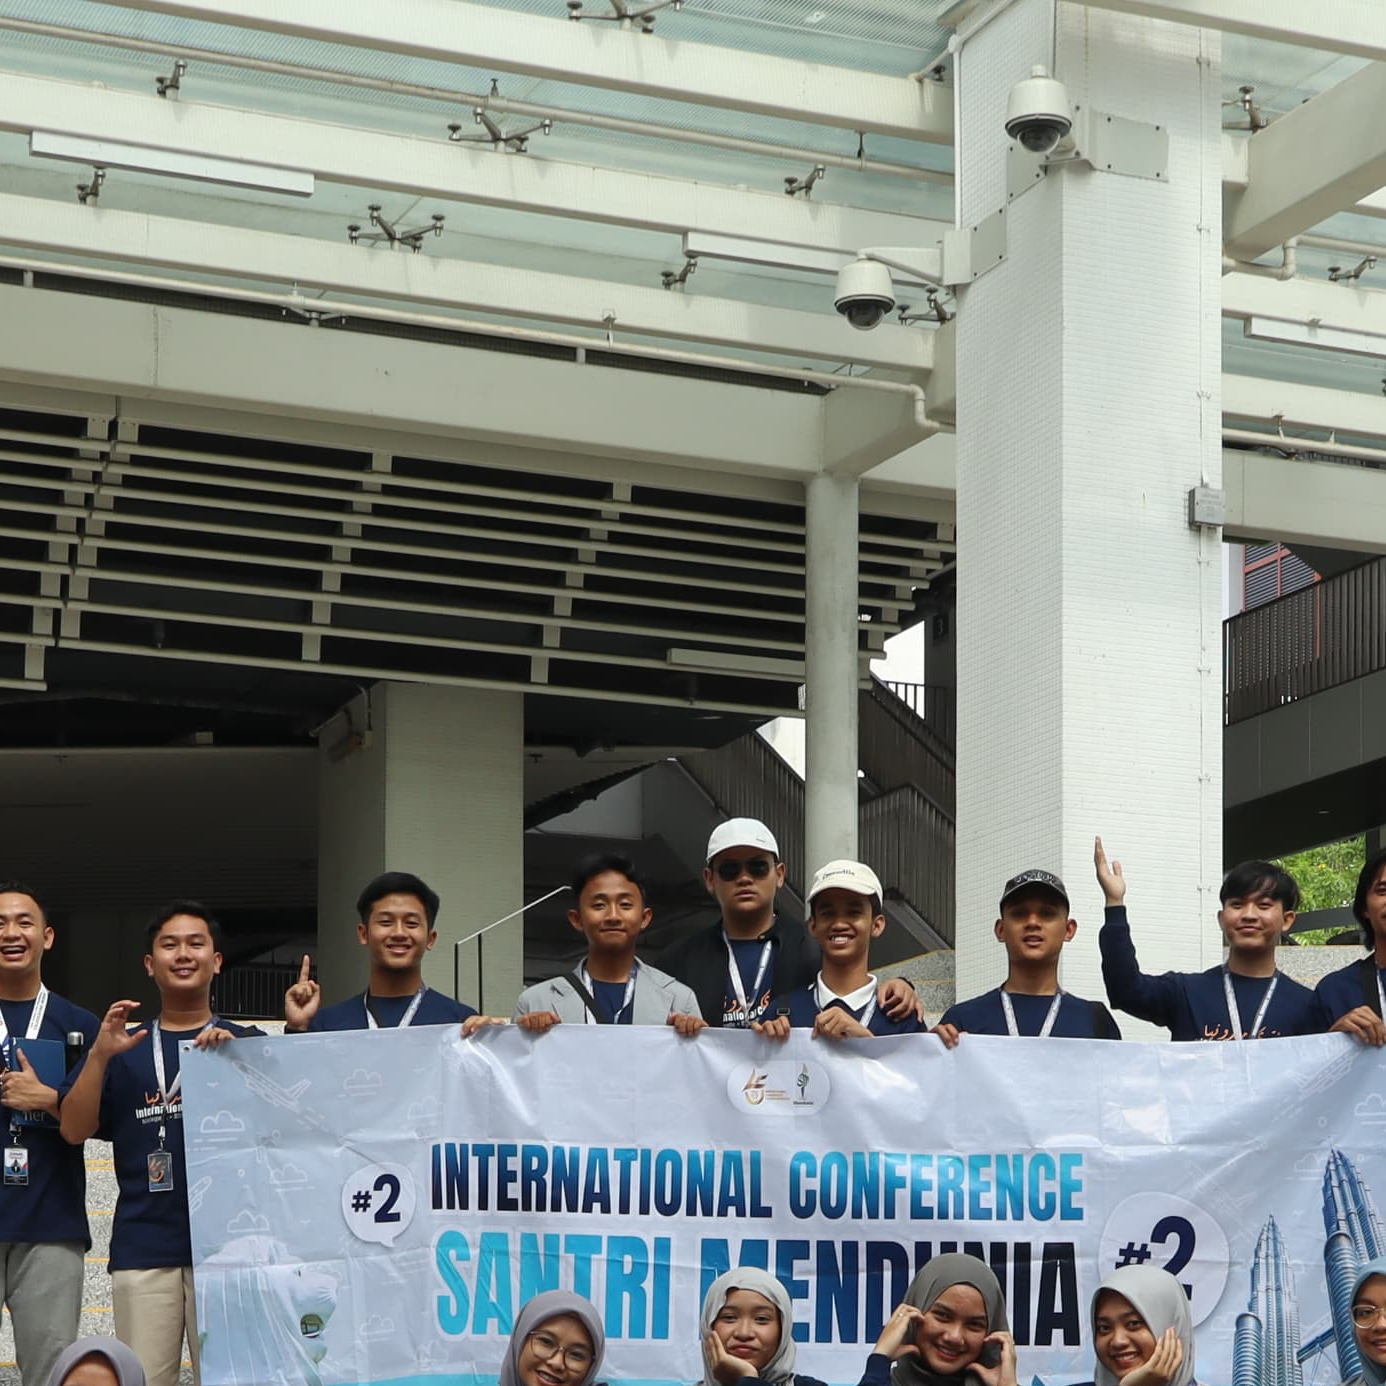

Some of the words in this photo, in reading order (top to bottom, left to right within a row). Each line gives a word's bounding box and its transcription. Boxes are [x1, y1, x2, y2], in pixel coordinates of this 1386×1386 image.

[351, 1173, 401, 1223] #2
[431, 1142, 772, 1218] INTERNATIONAL
[788, 1150, 1084, 1221] CONFERENCE
[435, 1229, 671, 1340] SANTRI
